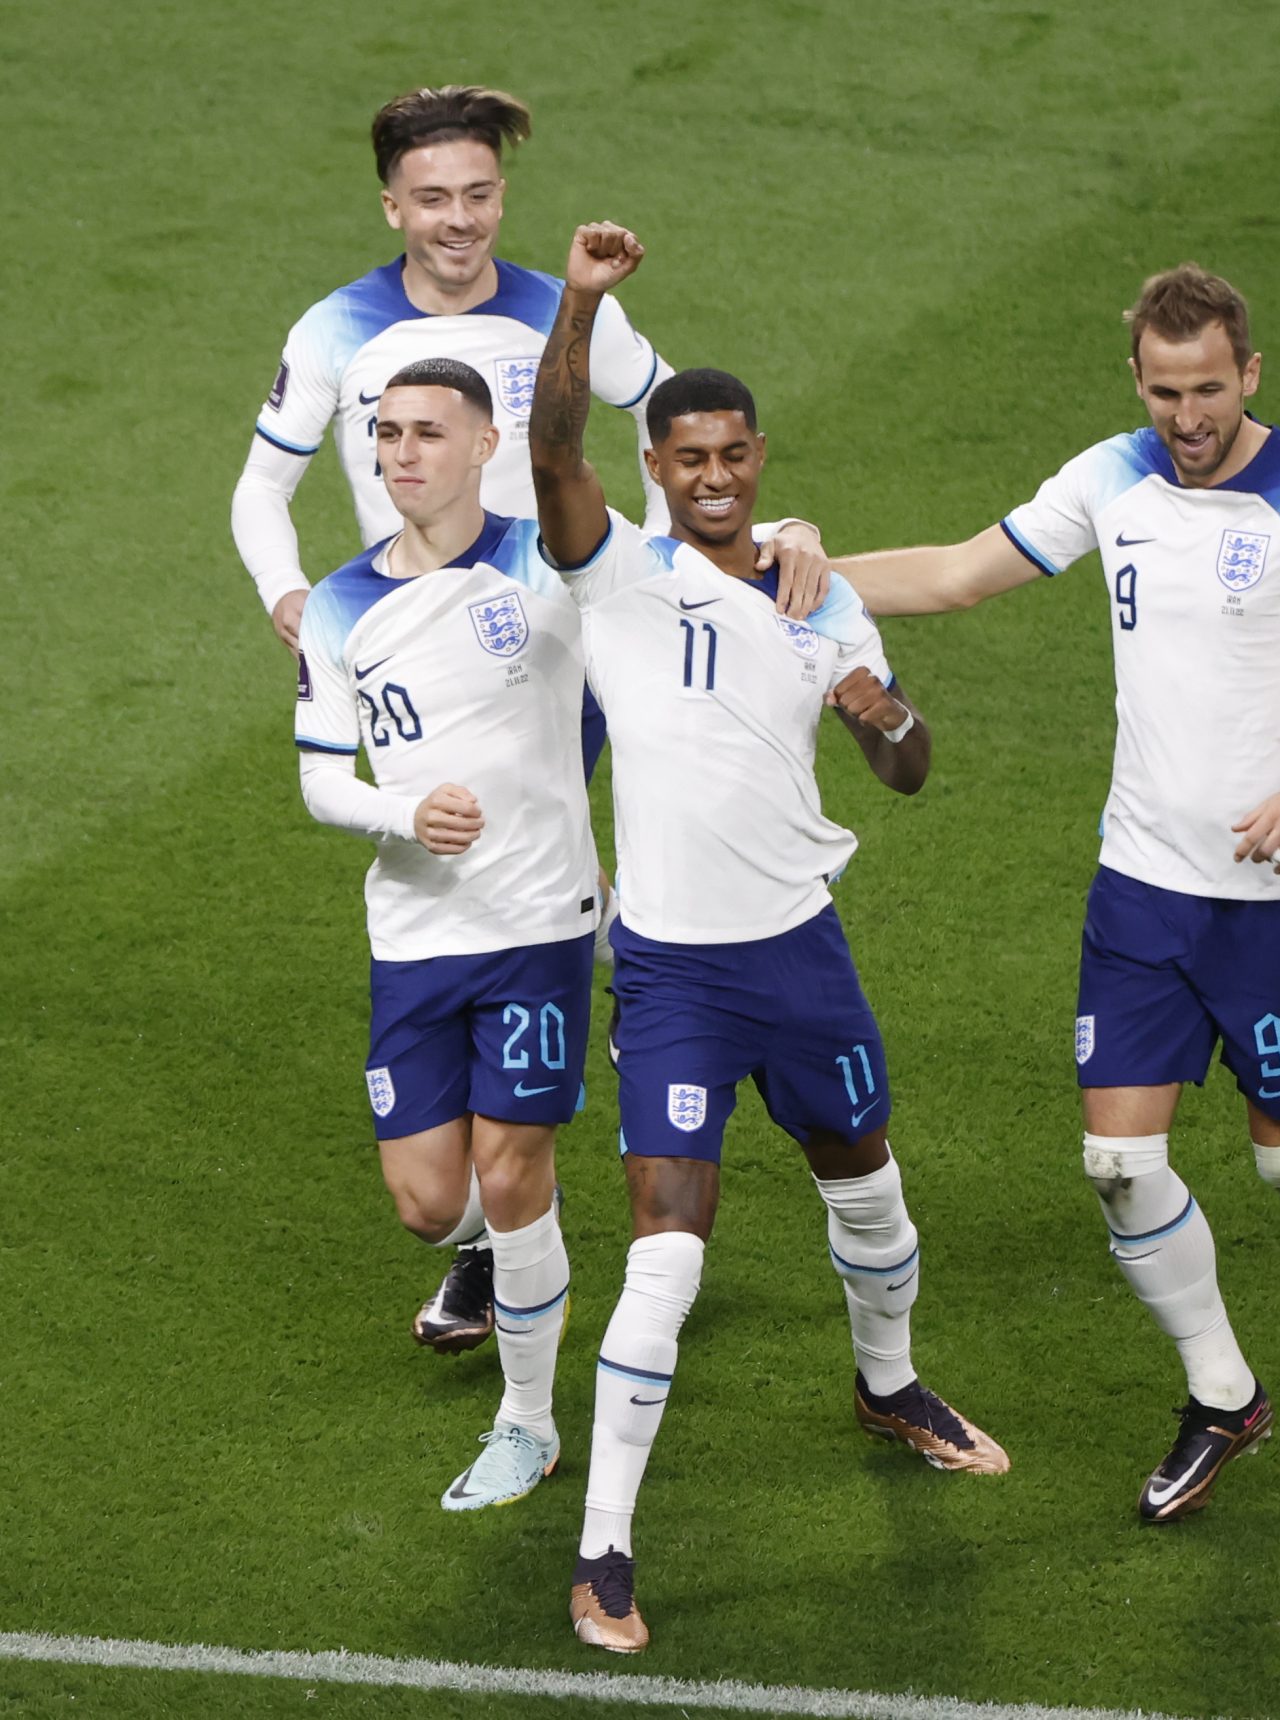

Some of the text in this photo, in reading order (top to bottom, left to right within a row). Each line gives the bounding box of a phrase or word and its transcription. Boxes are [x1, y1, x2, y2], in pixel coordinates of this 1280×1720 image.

[1116, 563, 1137, 631] 9
[679, 619, 717, 690] 11
[356, 682, 423, 747] 20
[503, 1002, 566, 1070] 20
[835, 1045, 875, 1106] 11
